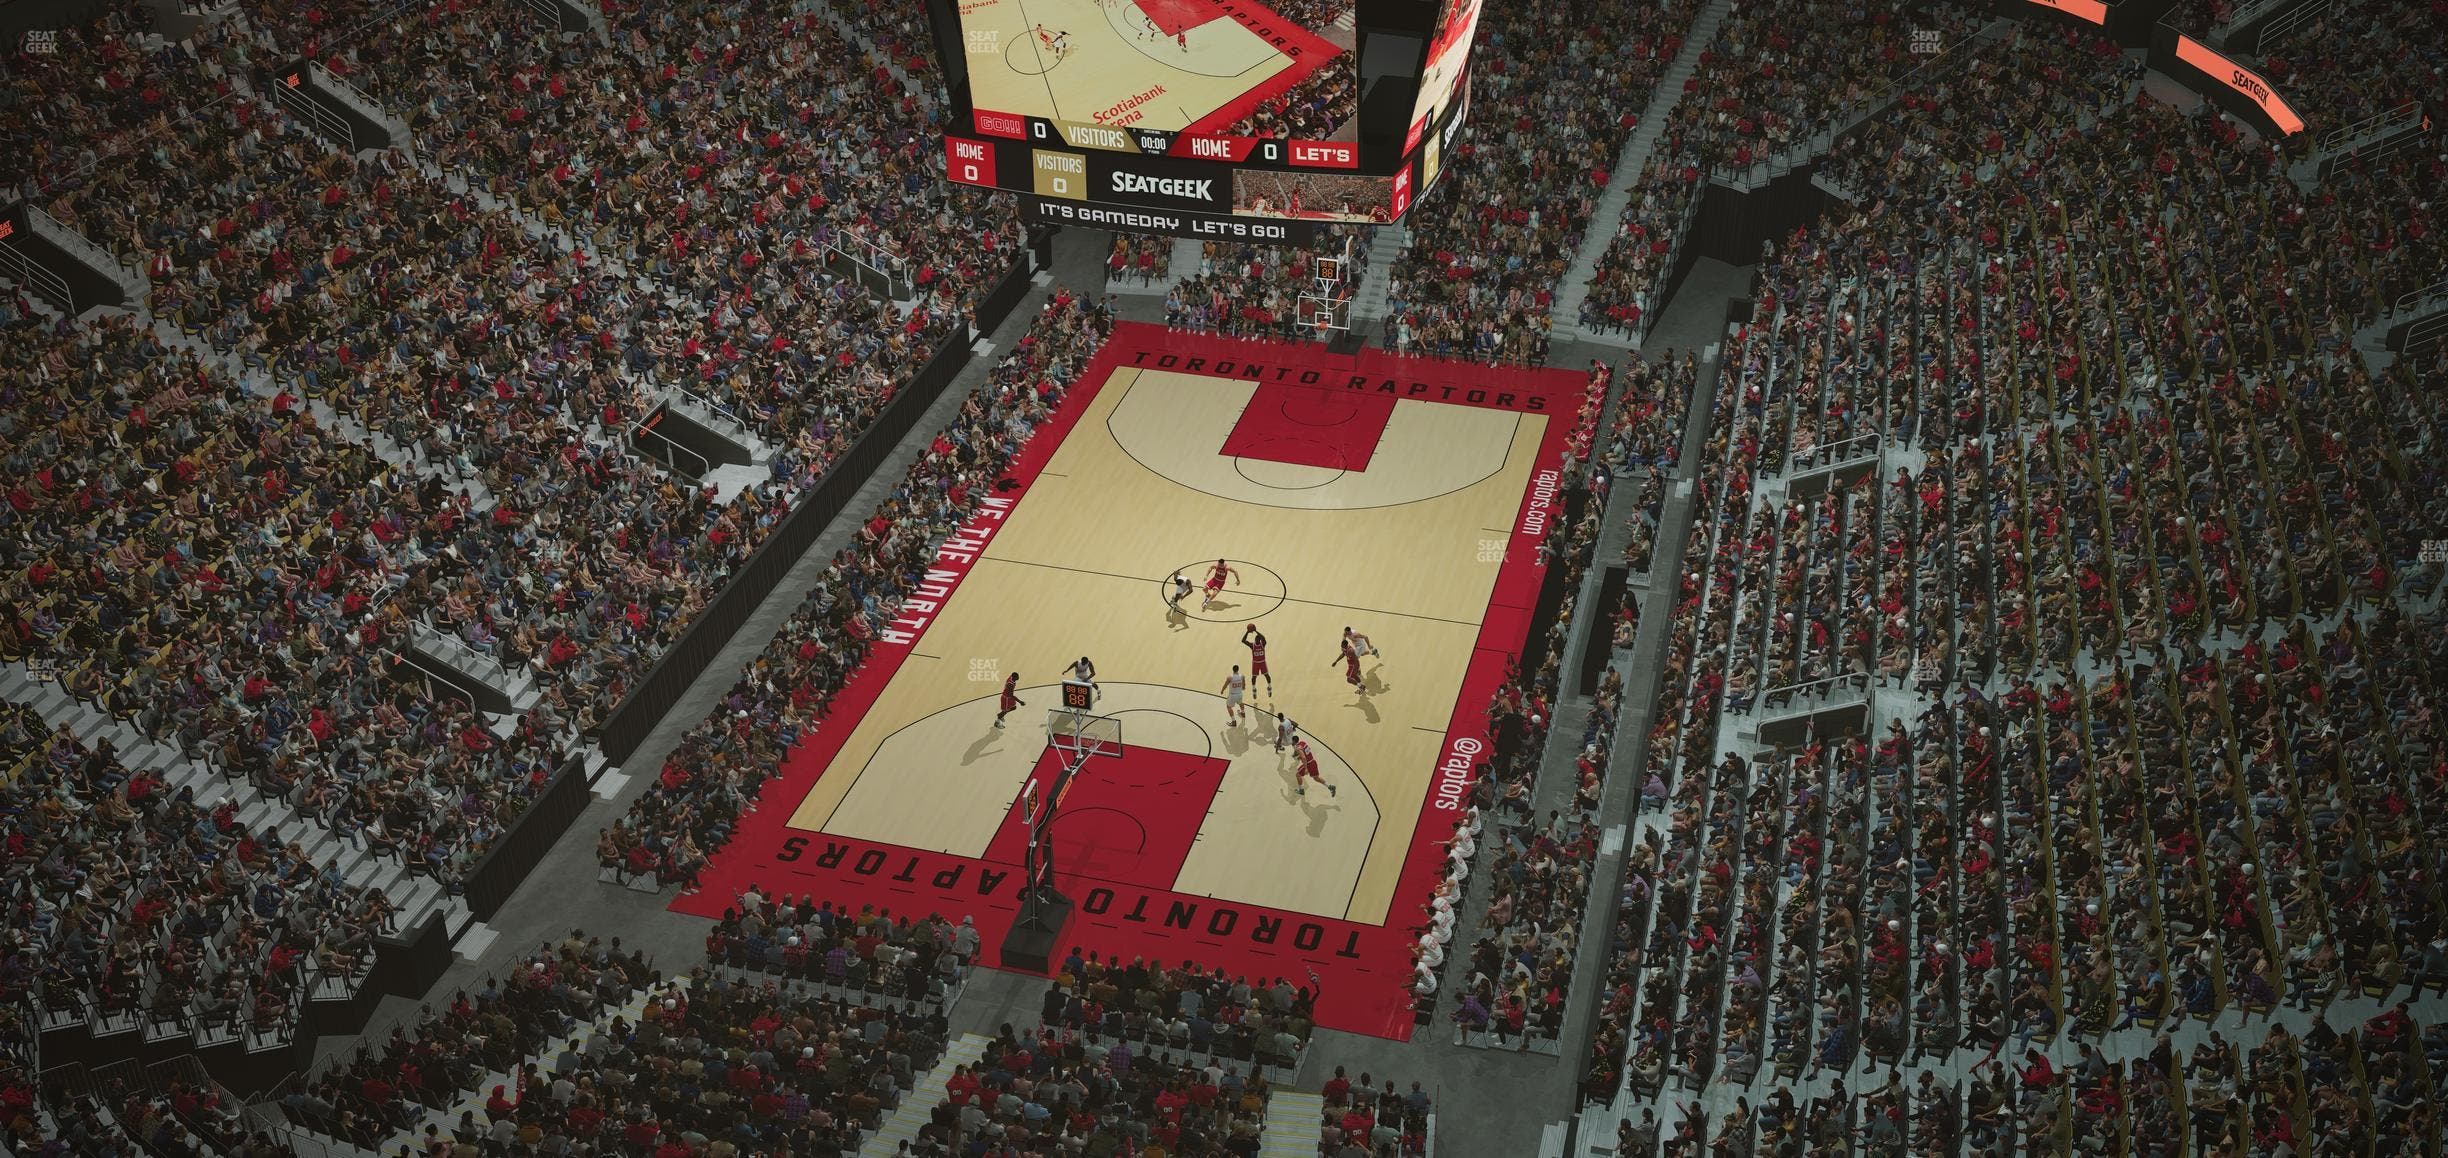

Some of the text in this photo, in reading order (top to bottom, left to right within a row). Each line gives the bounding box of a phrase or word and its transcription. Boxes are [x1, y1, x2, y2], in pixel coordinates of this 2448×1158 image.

[2231, 70, 2269, 107] SEATGEEK
[1092, 84, 1167, 125] Scotiabank
[981, 116, 1021, 134] GO!!!
[1110, 110, 1143, 128] rena
[1034, 122, 1047, 139] 0
[1068, 125, 1125, 148] VISITORS
[956, 142, 985, 161] HOME
[1141, 136, 1166, 150] 00:00
[1192, 137, 1231, 158] HOME
[1264, 143, 1278, 160] 0
[1036, 153, 1082, 174] VISITORS
[1295, 147, 1350, 163] LET'S
[964, 165, 979, 181] 0
[1053, 177, 1068, 193] 0
[1111, 171, 1213, 202] SEATGEEK
[1040, 202, 1286, 239] IT'S GAMEDAY LET'S GO!
[1134, 351, 1547, 411] TORONTO RAPTORS
[1522, 469, 1559, 535] raptors.com
[881, 497, 1013, 645] WE THE NORTH
[1069, 693, 1085, 706] 88
[1435, 737, 1483, 811] @raptors
[776, 836, 1361, 960] TORONTO APTORS
